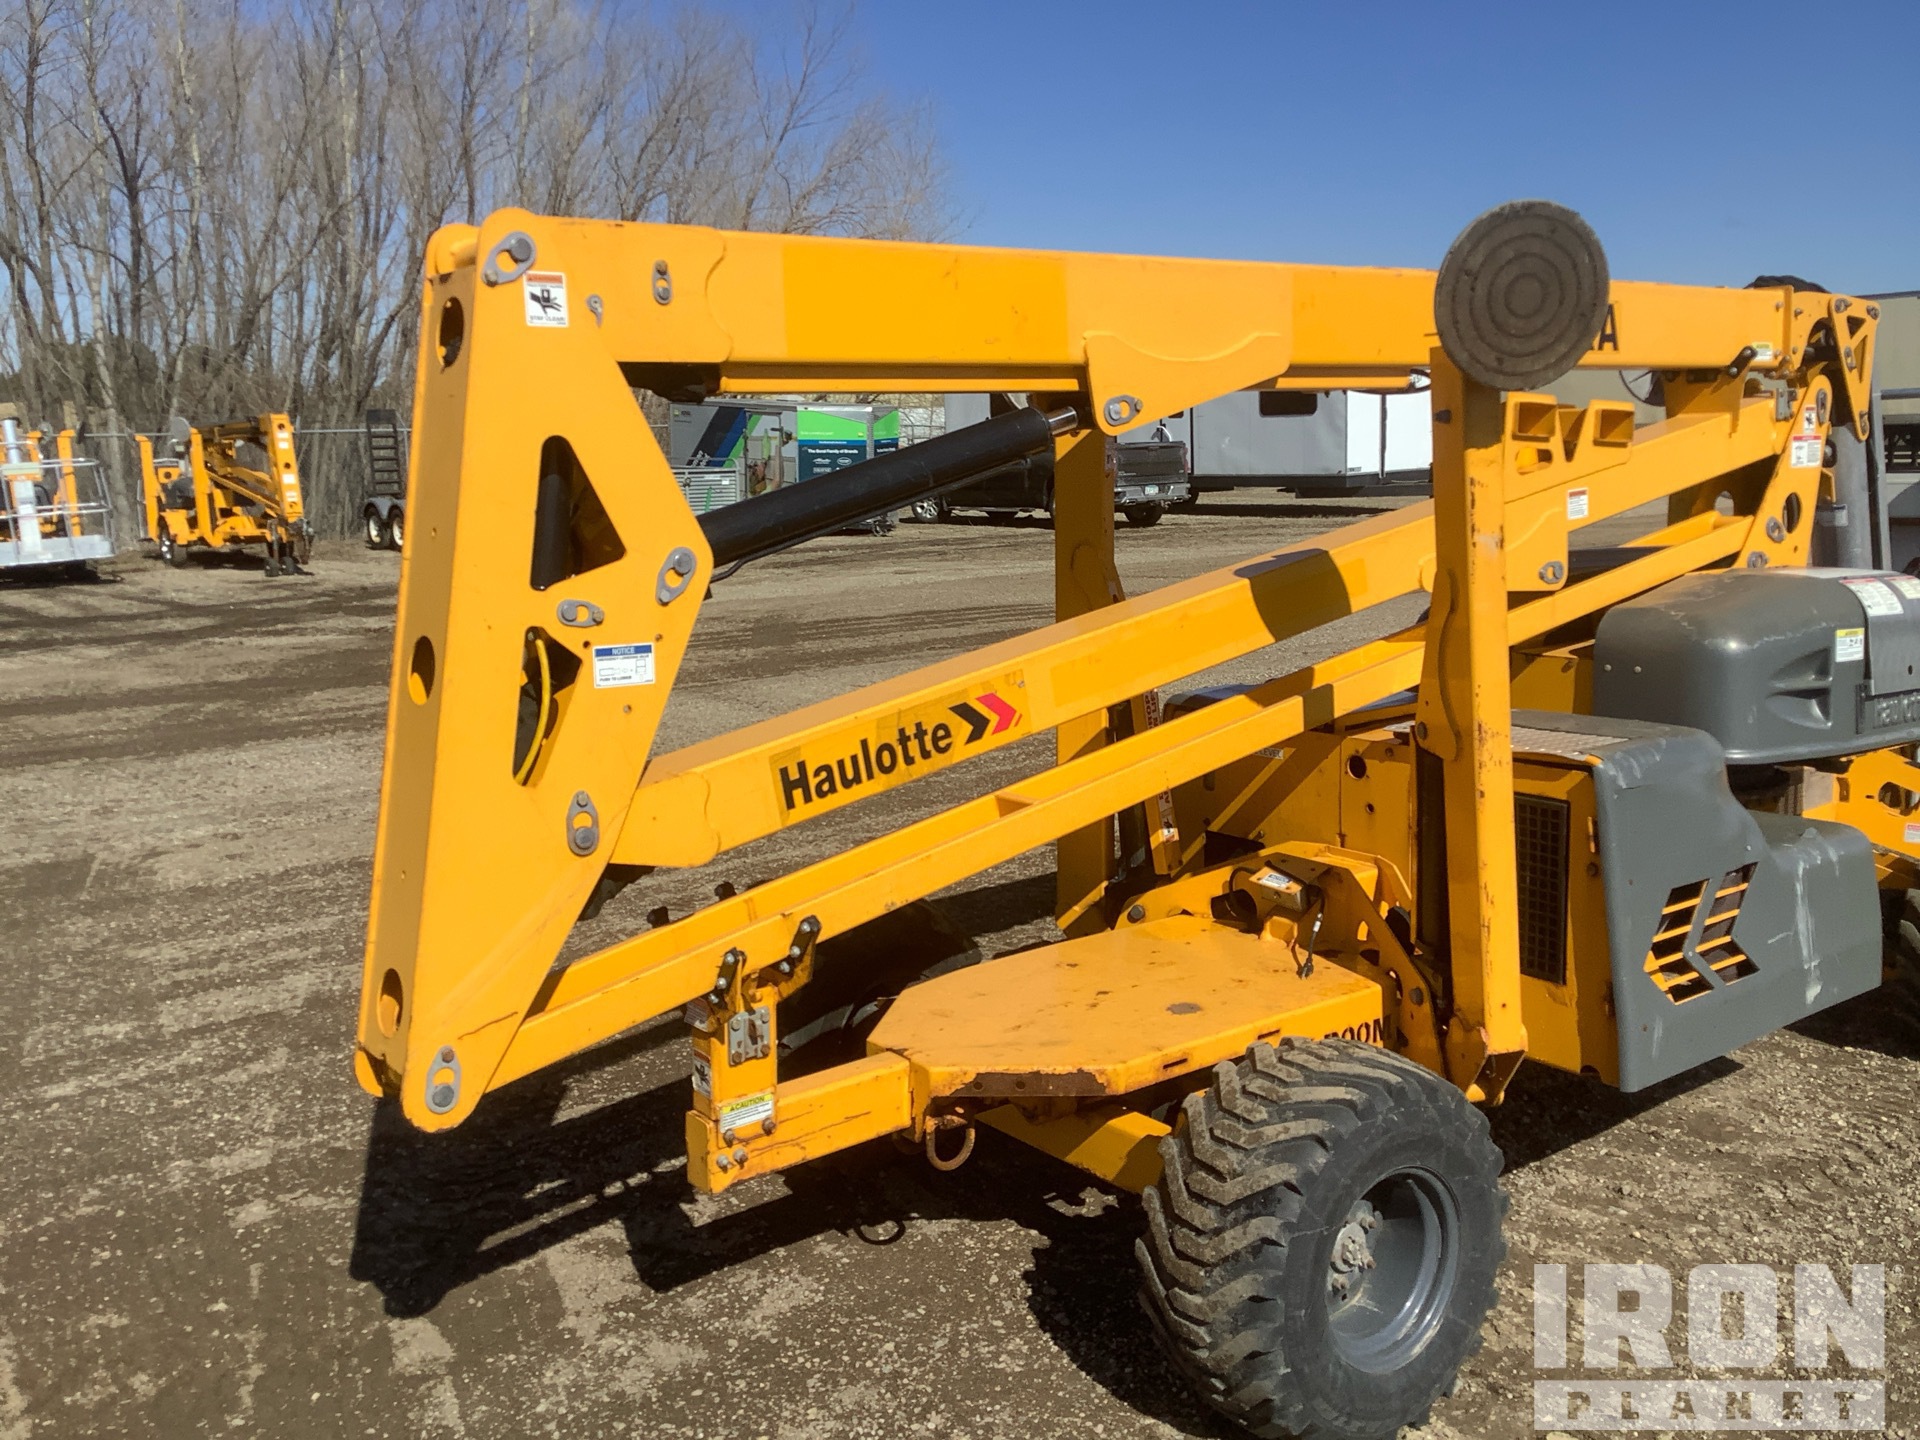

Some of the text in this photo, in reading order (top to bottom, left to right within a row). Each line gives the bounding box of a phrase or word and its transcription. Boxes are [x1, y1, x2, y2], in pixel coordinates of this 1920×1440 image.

[1591, 304, 1619, 351] A
[611, 646, 635, 656] NOTICE
[1144, 694, 1153, 727] ROP
[778, 721, 953, 812] Haulotte
[1323, 1016, 1392, 1043] OOM
[735, 1095, 765, 1109] CAUTION
